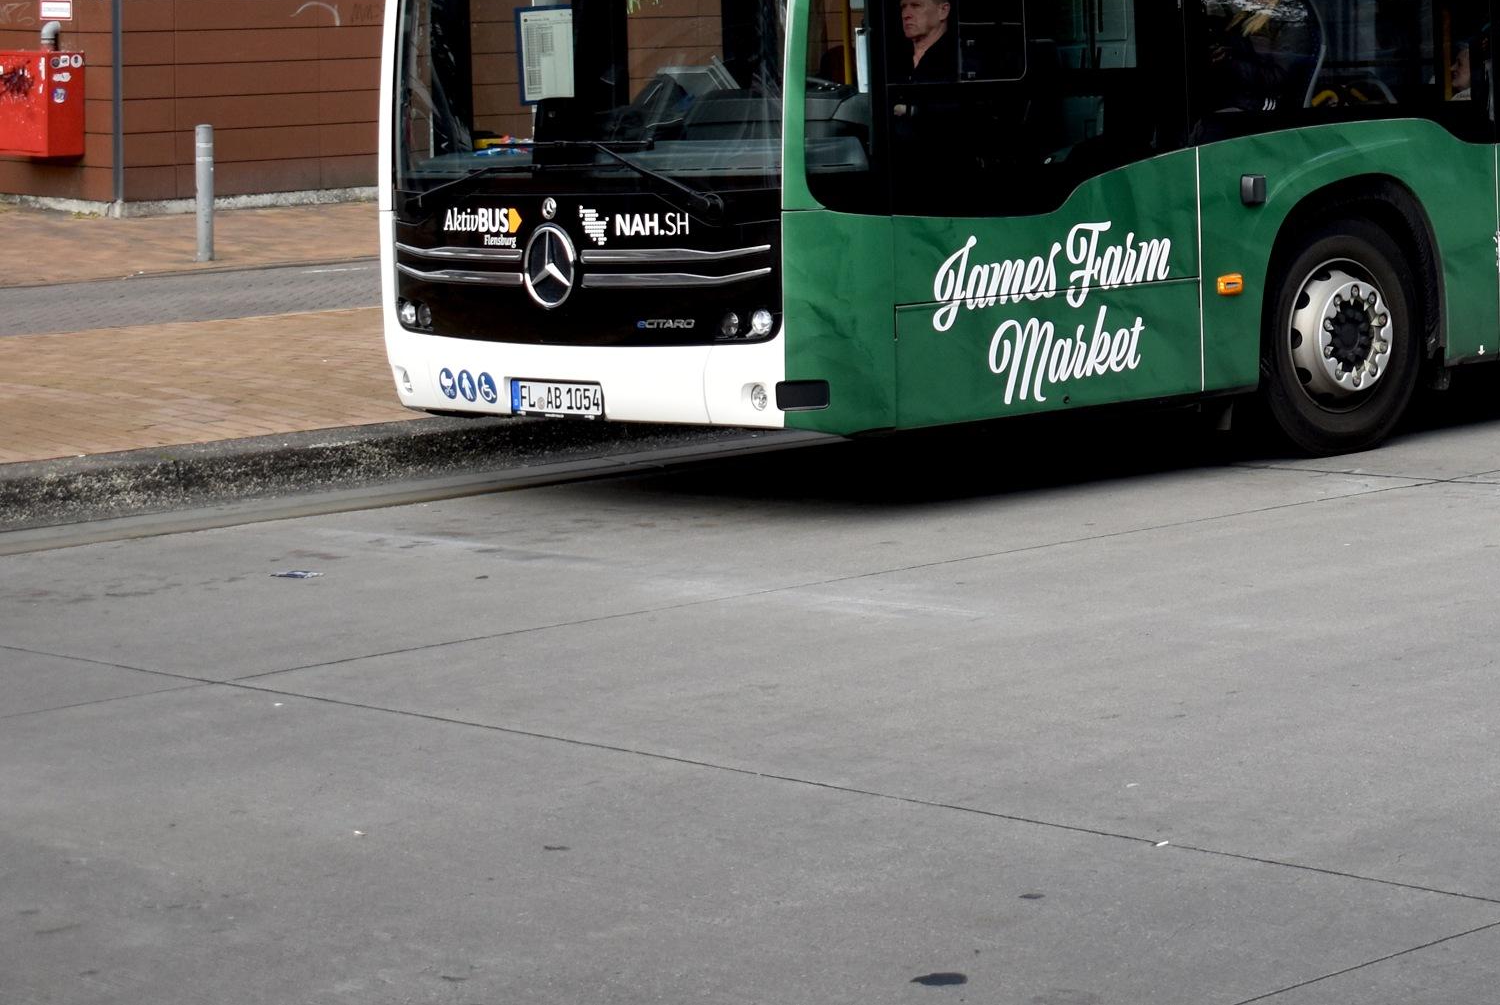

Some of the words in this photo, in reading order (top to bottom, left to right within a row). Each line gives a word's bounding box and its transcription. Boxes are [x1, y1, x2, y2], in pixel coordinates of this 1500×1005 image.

[443, 207, 509, 233] AktivBUS
[615, 212, 690, 236] NAH.SH
[484, 234, 517, 249] Flensburg
[932, 235, 1062, 332] James
[1065, 221, 1172, 308] Farm
[988, 305, 1146, 405] Market
[520, 385, 536, 408] FL
[546, 386, 563, 410] AB
[566, 387, 601, 412] 1054
